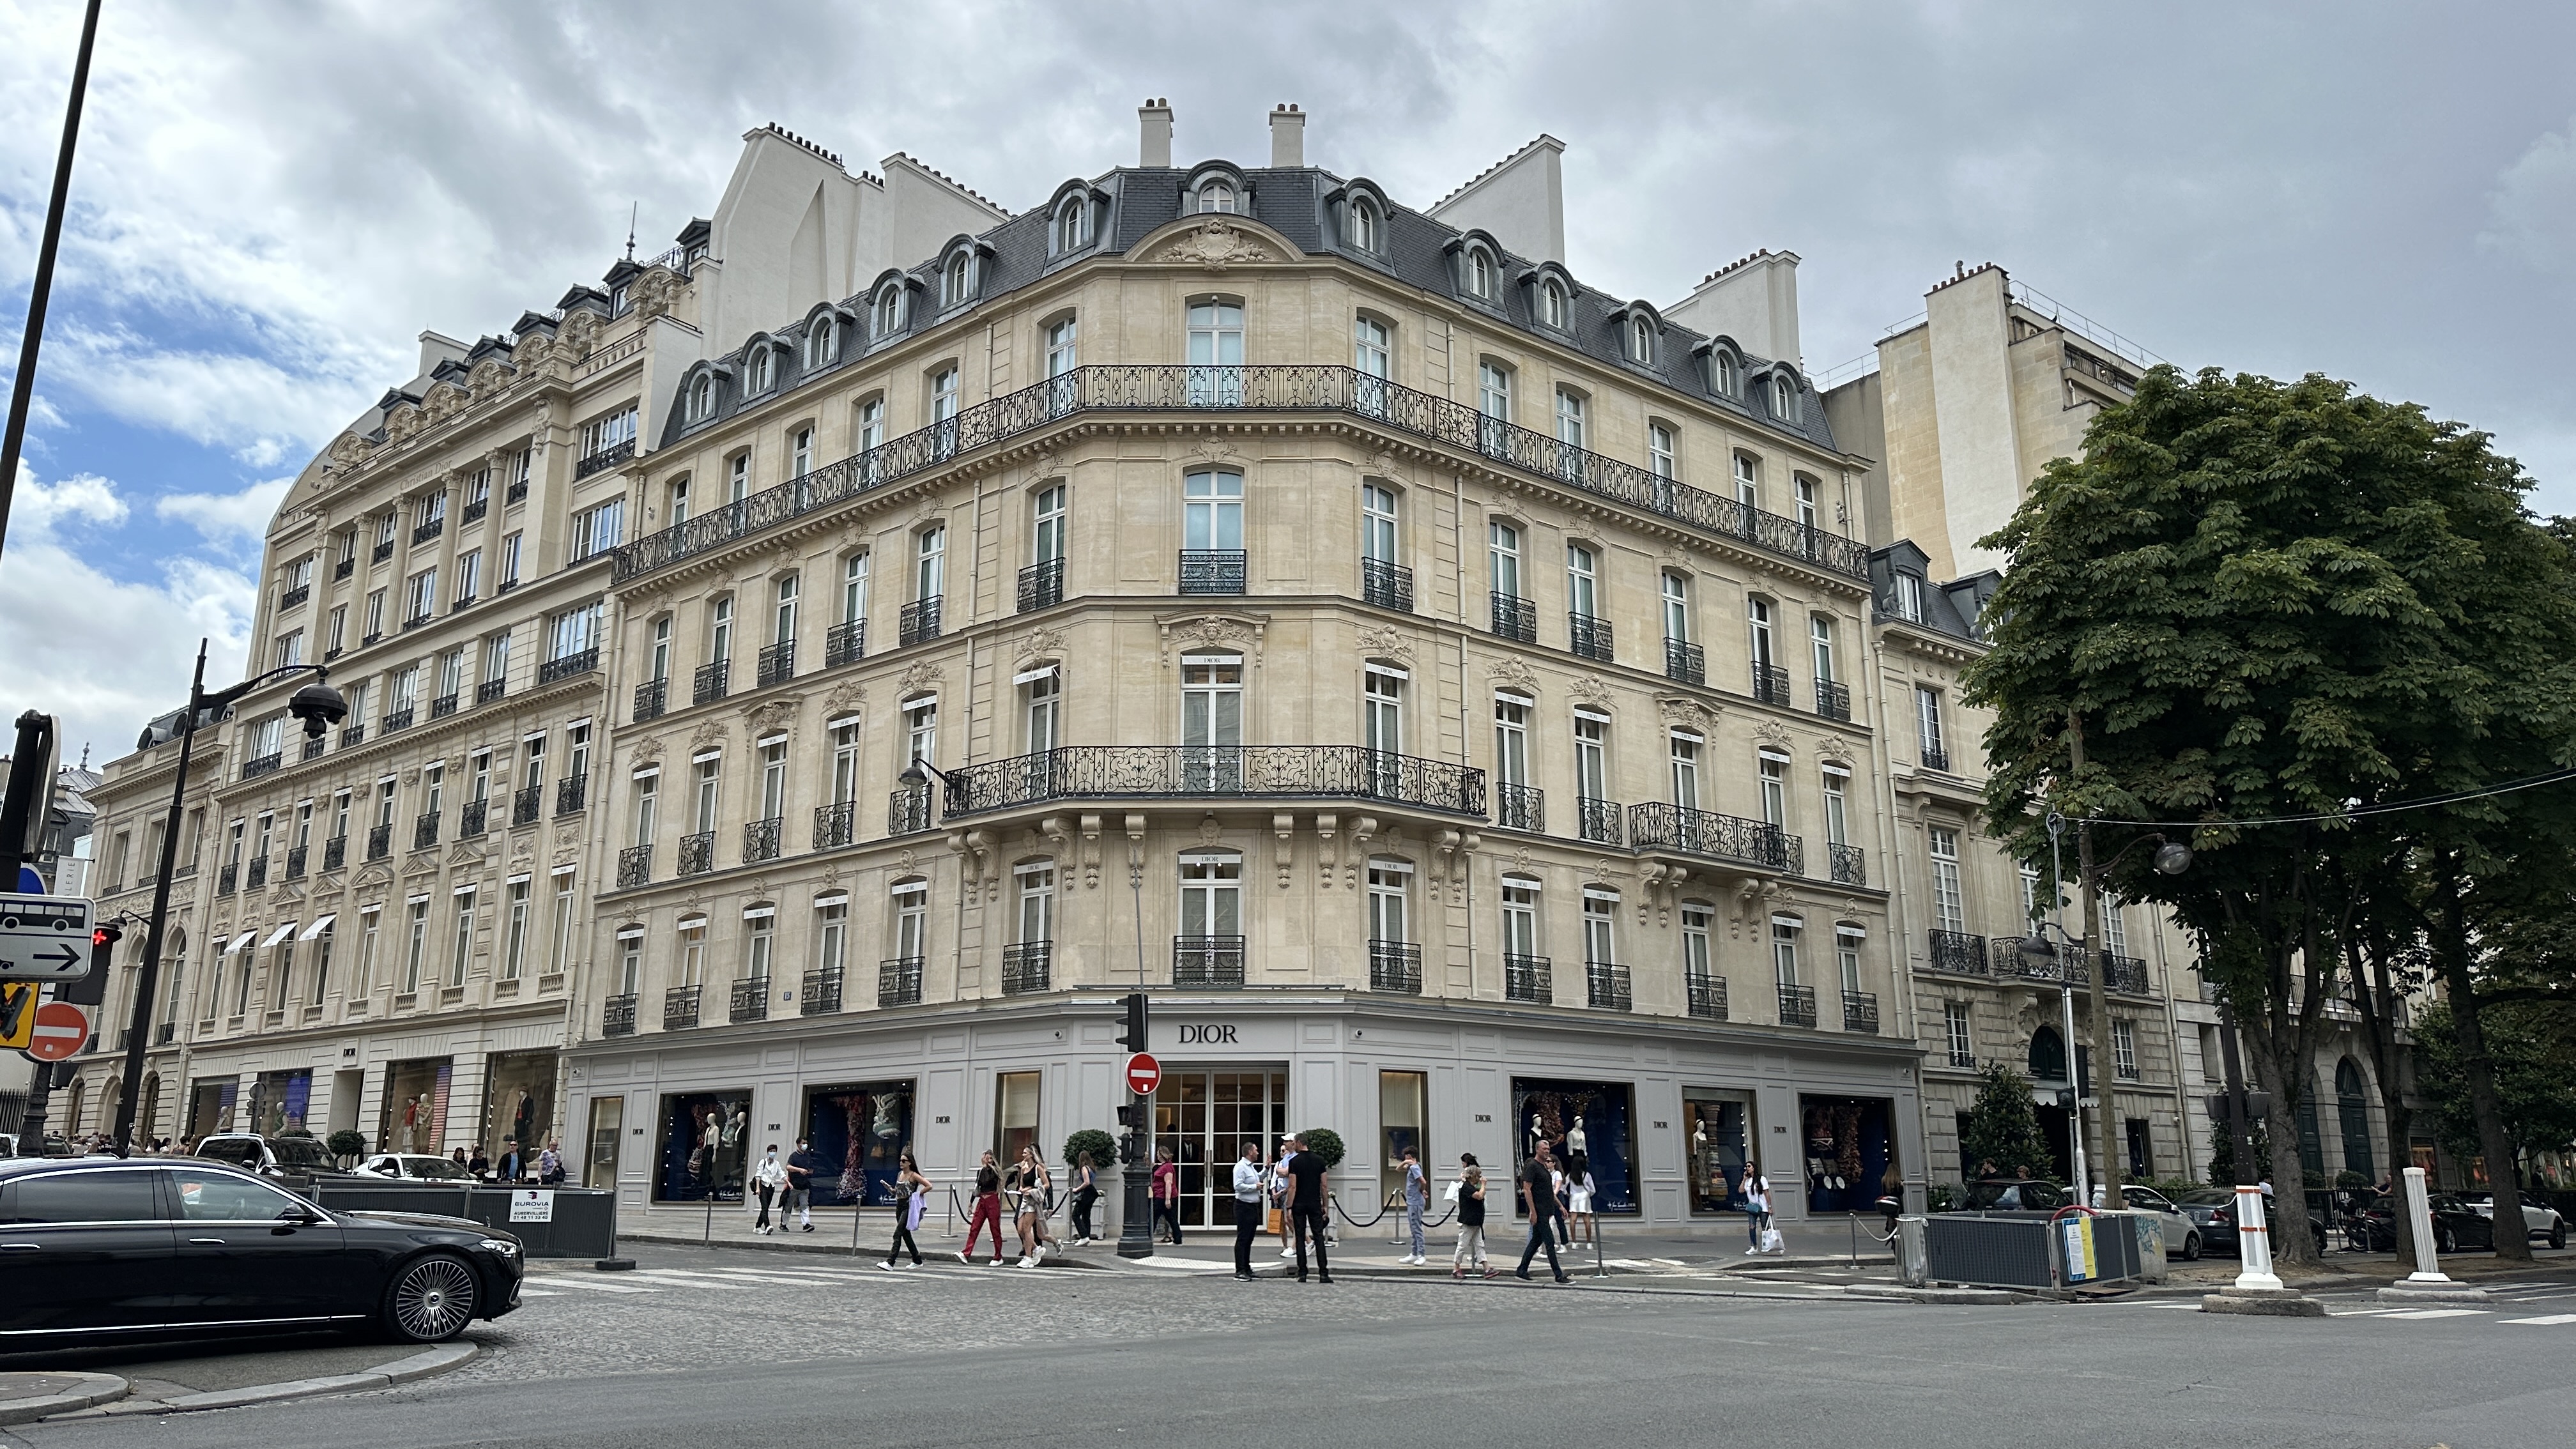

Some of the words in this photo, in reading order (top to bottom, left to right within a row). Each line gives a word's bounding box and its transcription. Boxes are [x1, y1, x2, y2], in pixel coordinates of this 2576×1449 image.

[400, 470, 433, 491] Christian
[435, 460, 452, 473] Dior
[1179, 1025, 1238, 1043] DIOR
[343, 1048, 356, 1057] DIOR
[935, 1116, 951, 1124] DIOR
[1475, 1114, 1492, 1123] DIOR
